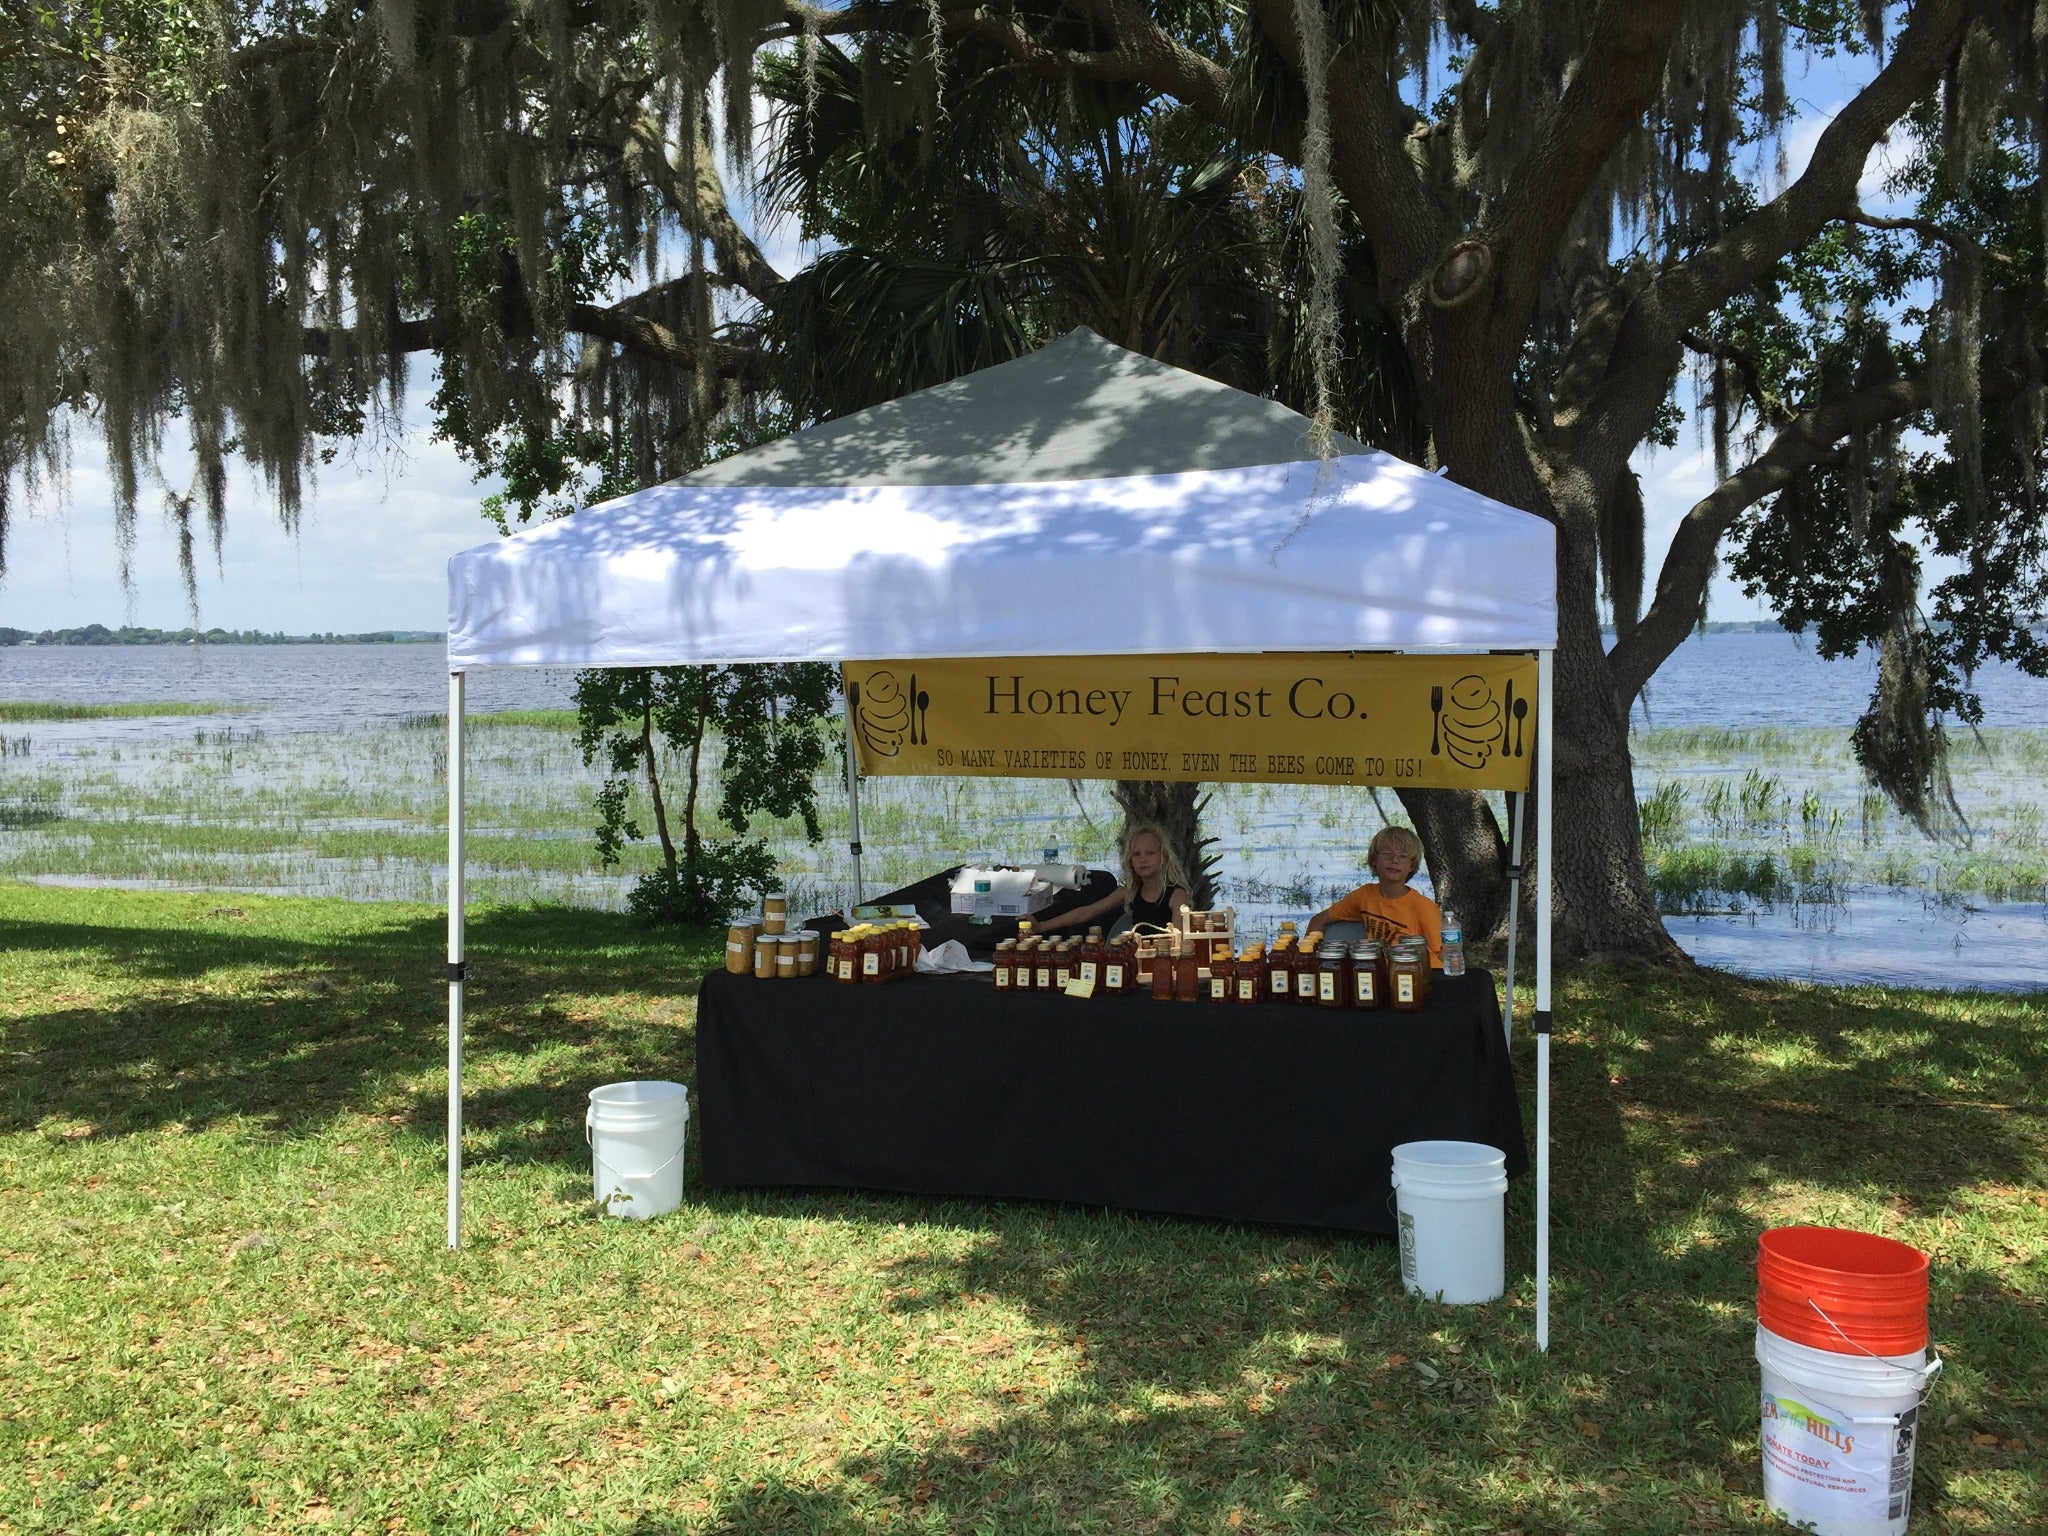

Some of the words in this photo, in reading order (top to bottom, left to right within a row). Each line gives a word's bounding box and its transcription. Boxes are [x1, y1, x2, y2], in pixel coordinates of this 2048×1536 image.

[984, 676, 1132, 726] Honey
[1148, 676, 1272, 718] Feast
[1288, 677, 1368, 720] Co.
[937, 749, 954, 767] SO
[961, 750, 996, 768] MANY
[1004, 750, 1086, 769] VARIETIES
[1096, 751, 1113, 770] OF
[1182, 753, 1220, 772] EVEN
[1229, 754, 1257, 773] THE
[1267, 755, 1305, 775] BEES
[1315, 757, 1355, 776] COME
[1365, 758, 1384, 777] TO
[1395, 758, 1422, 778] US!
[1806, 1416, 1855, 1454] HILLS
[1795, 1452, 1830, 1468] TODAY
[1800, 1468, 1840, 1482] PROTECTING
